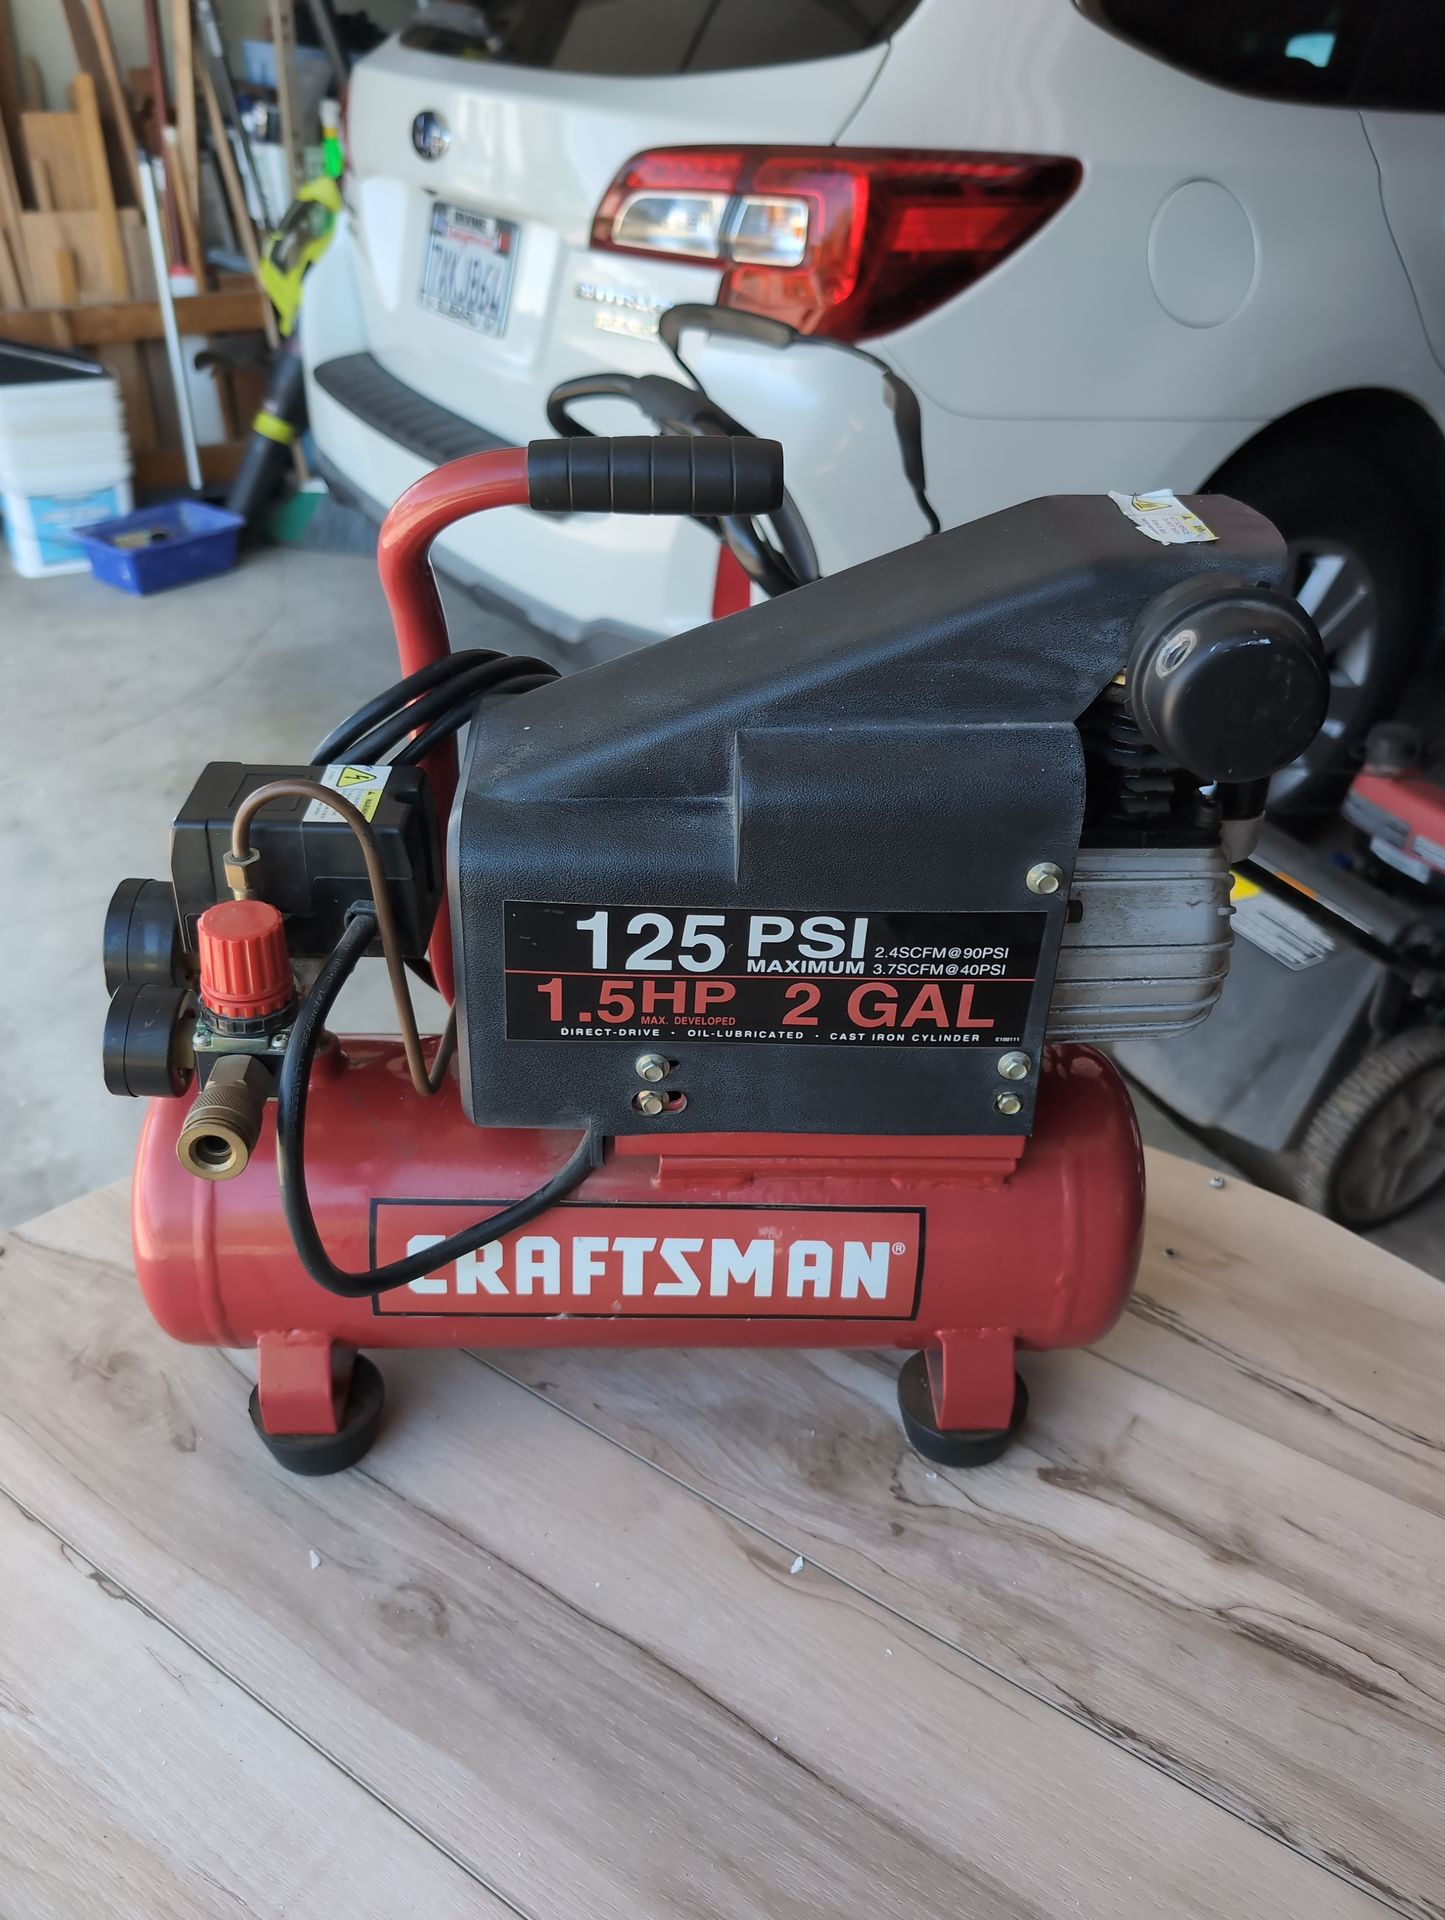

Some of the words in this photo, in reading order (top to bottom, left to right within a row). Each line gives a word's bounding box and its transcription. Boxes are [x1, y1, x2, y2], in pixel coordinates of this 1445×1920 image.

[576, 911, 726, 973] 125
[747, 915, 869, 959] PSI
[874, 946, 1010, 960] 2.4SCFM@90PSI
[747, 959, 865, 975] MAXIMUM
[872, 963, 1007, 977] 3.7SCFM@40PSI
[537, 976, 737, 1025] 1.5HP
[782, 982, 822, 1027] 2
[847, 982, 995, 1029] GAL
[640, 1016, 669, 1026] MAX.
[674, 1016, 736, 1026] DEVELOPED
[560, 1026, 660, 1037] DIRECT-DRIVE
[687, 1028, 804, 1040] OIL-LUBRICATED
[829, 1032, 866, 1042] CAST
[871, 1034, 906, 1043] IRON
[911, 1034, 981, 1043] CYLINDER
[406, 1234, 890, 1300] CRAFTSMAN
